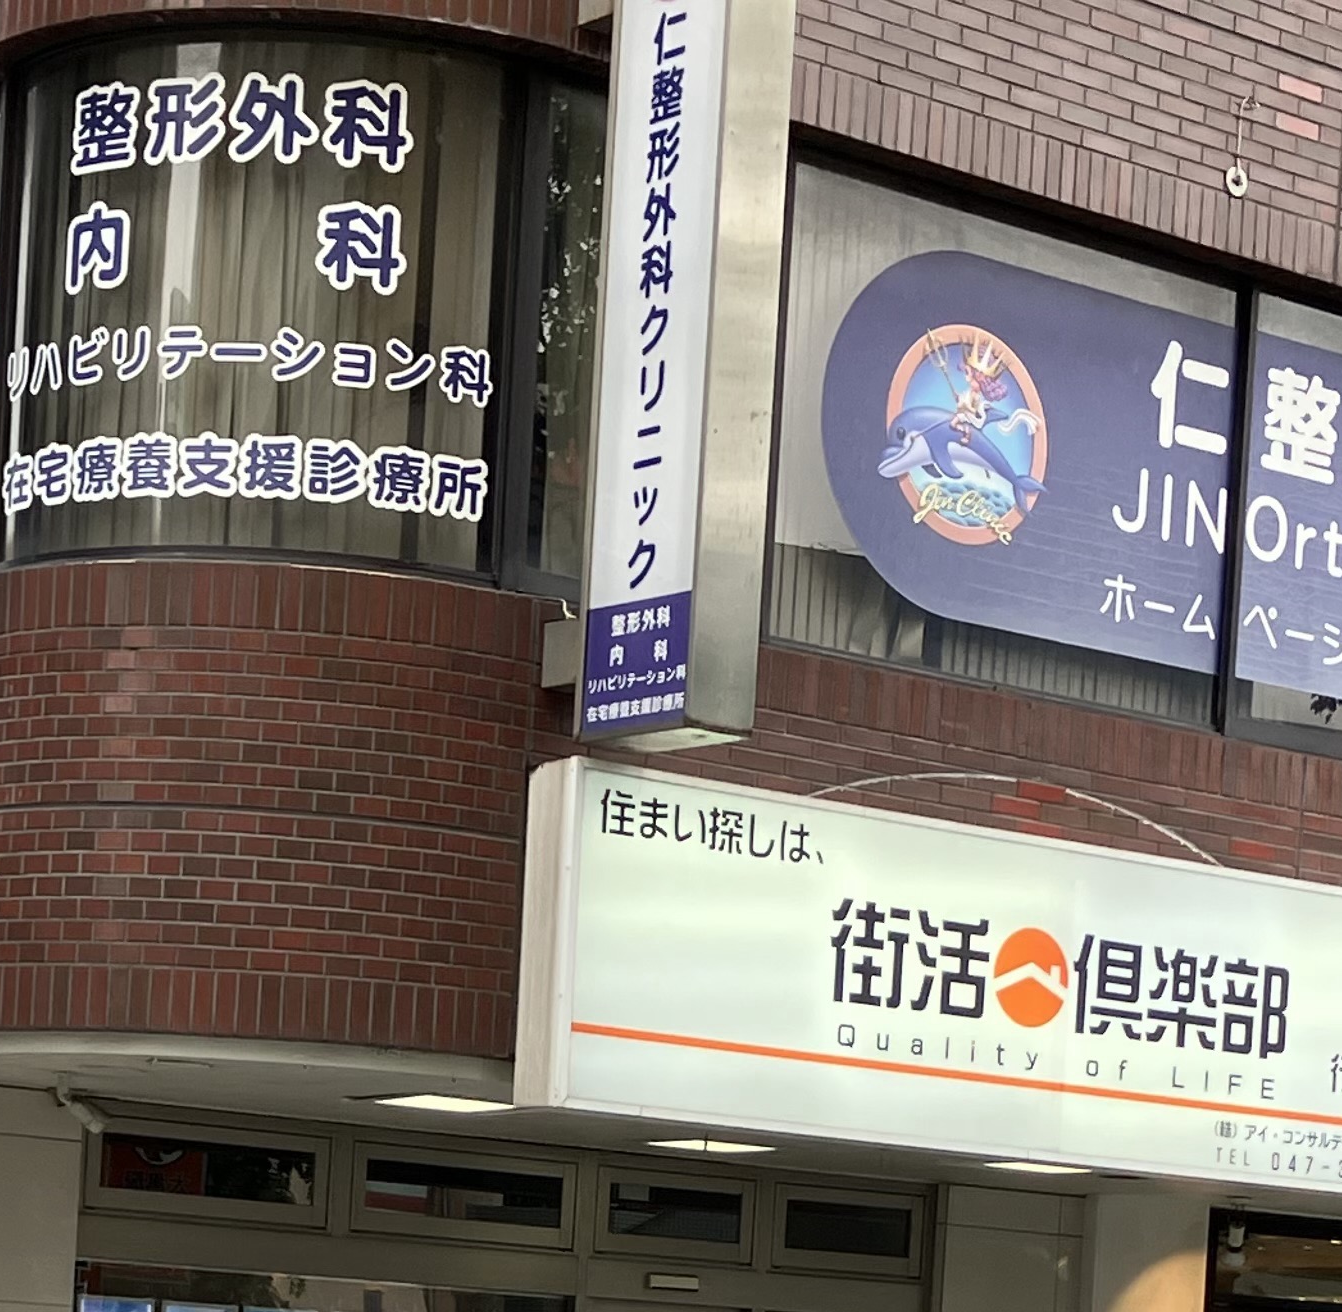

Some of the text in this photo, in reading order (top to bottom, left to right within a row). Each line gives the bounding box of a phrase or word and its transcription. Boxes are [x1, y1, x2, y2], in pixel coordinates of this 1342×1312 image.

[70, 72, 413, 174] 整形外科
[627, 10, 689, 592] 仁整形外科クリニック
[5, 326, 493, 407] リハビリテーション科
[4, 431, 488, 521] 在宅療養支援診療所
[1112, 467, 1229, 555] JIN
[611, 605, 671, 637] 整形外科
[588, 664, 686, 694] リハビリテーション科
[600, 787, 826, 865] 住まい探しは、
[836, 1023, 1278, 1101] Quality of LIFE
[1216, 1146, 1251, 1166] TEL
